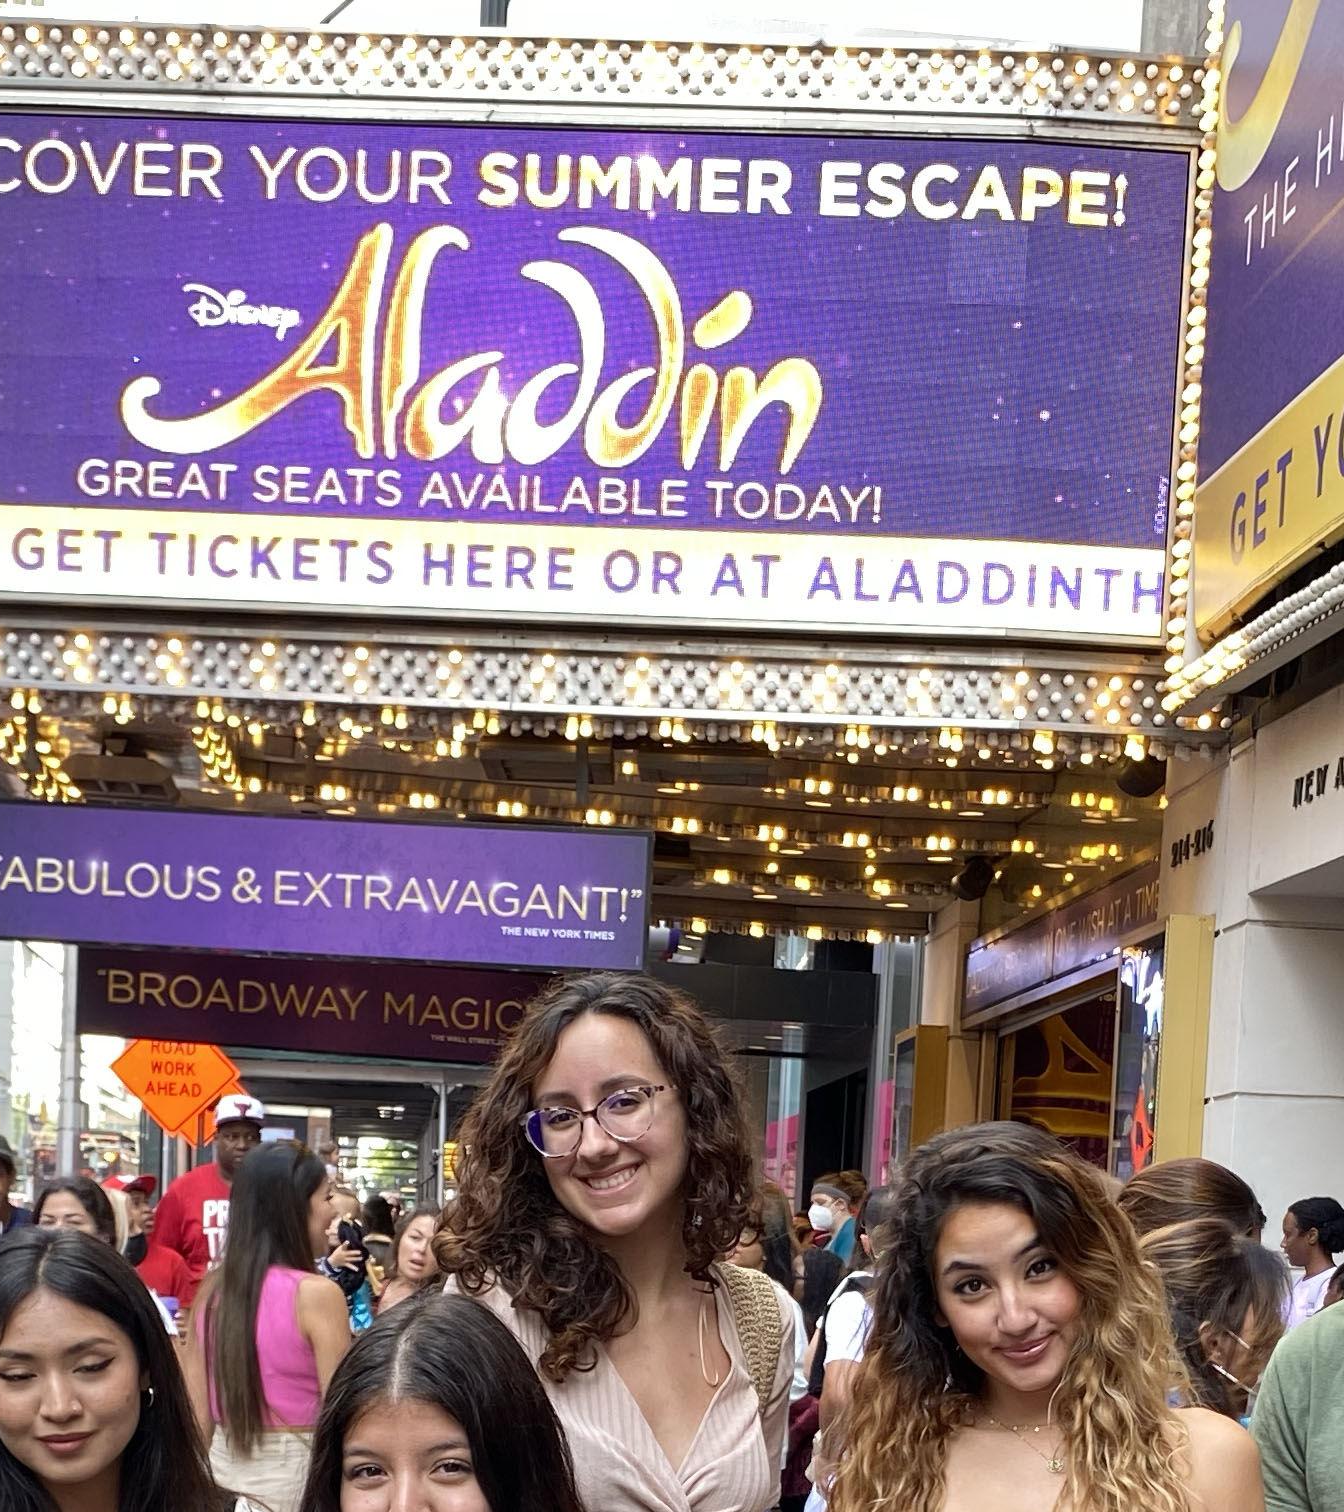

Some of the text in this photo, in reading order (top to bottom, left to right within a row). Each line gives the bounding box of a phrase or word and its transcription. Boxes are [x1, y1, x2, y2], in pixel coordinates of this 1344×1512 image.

[250, 144, 454, 204] YOUR
[478, 152, 792, 215] SUMMER
[818, 160, 1129, 227] ESCAPE!
[1245, 156, 1299, 265] THE
[183, 283, 300, 340] Disney
[122, 222, 823, 474] Aladdin
[76, 458, 883, 524] GREAT SEATS AVAILABLE TODAY!
[1230, 456, 1293, 566] GET
[10, 526, 123, 574] GET
[147, 531, 395, 585] TICKETS
[421, 542, 576, 591] HERE
[602, 549, 682, 595] OR
[710, 553, 782, 600] AT
[1291, 763, 1329, 808] NEW
[231, 867, 263, 905] &
[500, 926, 616, 941] THE NEW YORK TIMES
[151, 1040, 197, 1056] ROAD
[151, 1061, 196, 1077] WORK
[145, 1080, 202, 1098] AHEAD
